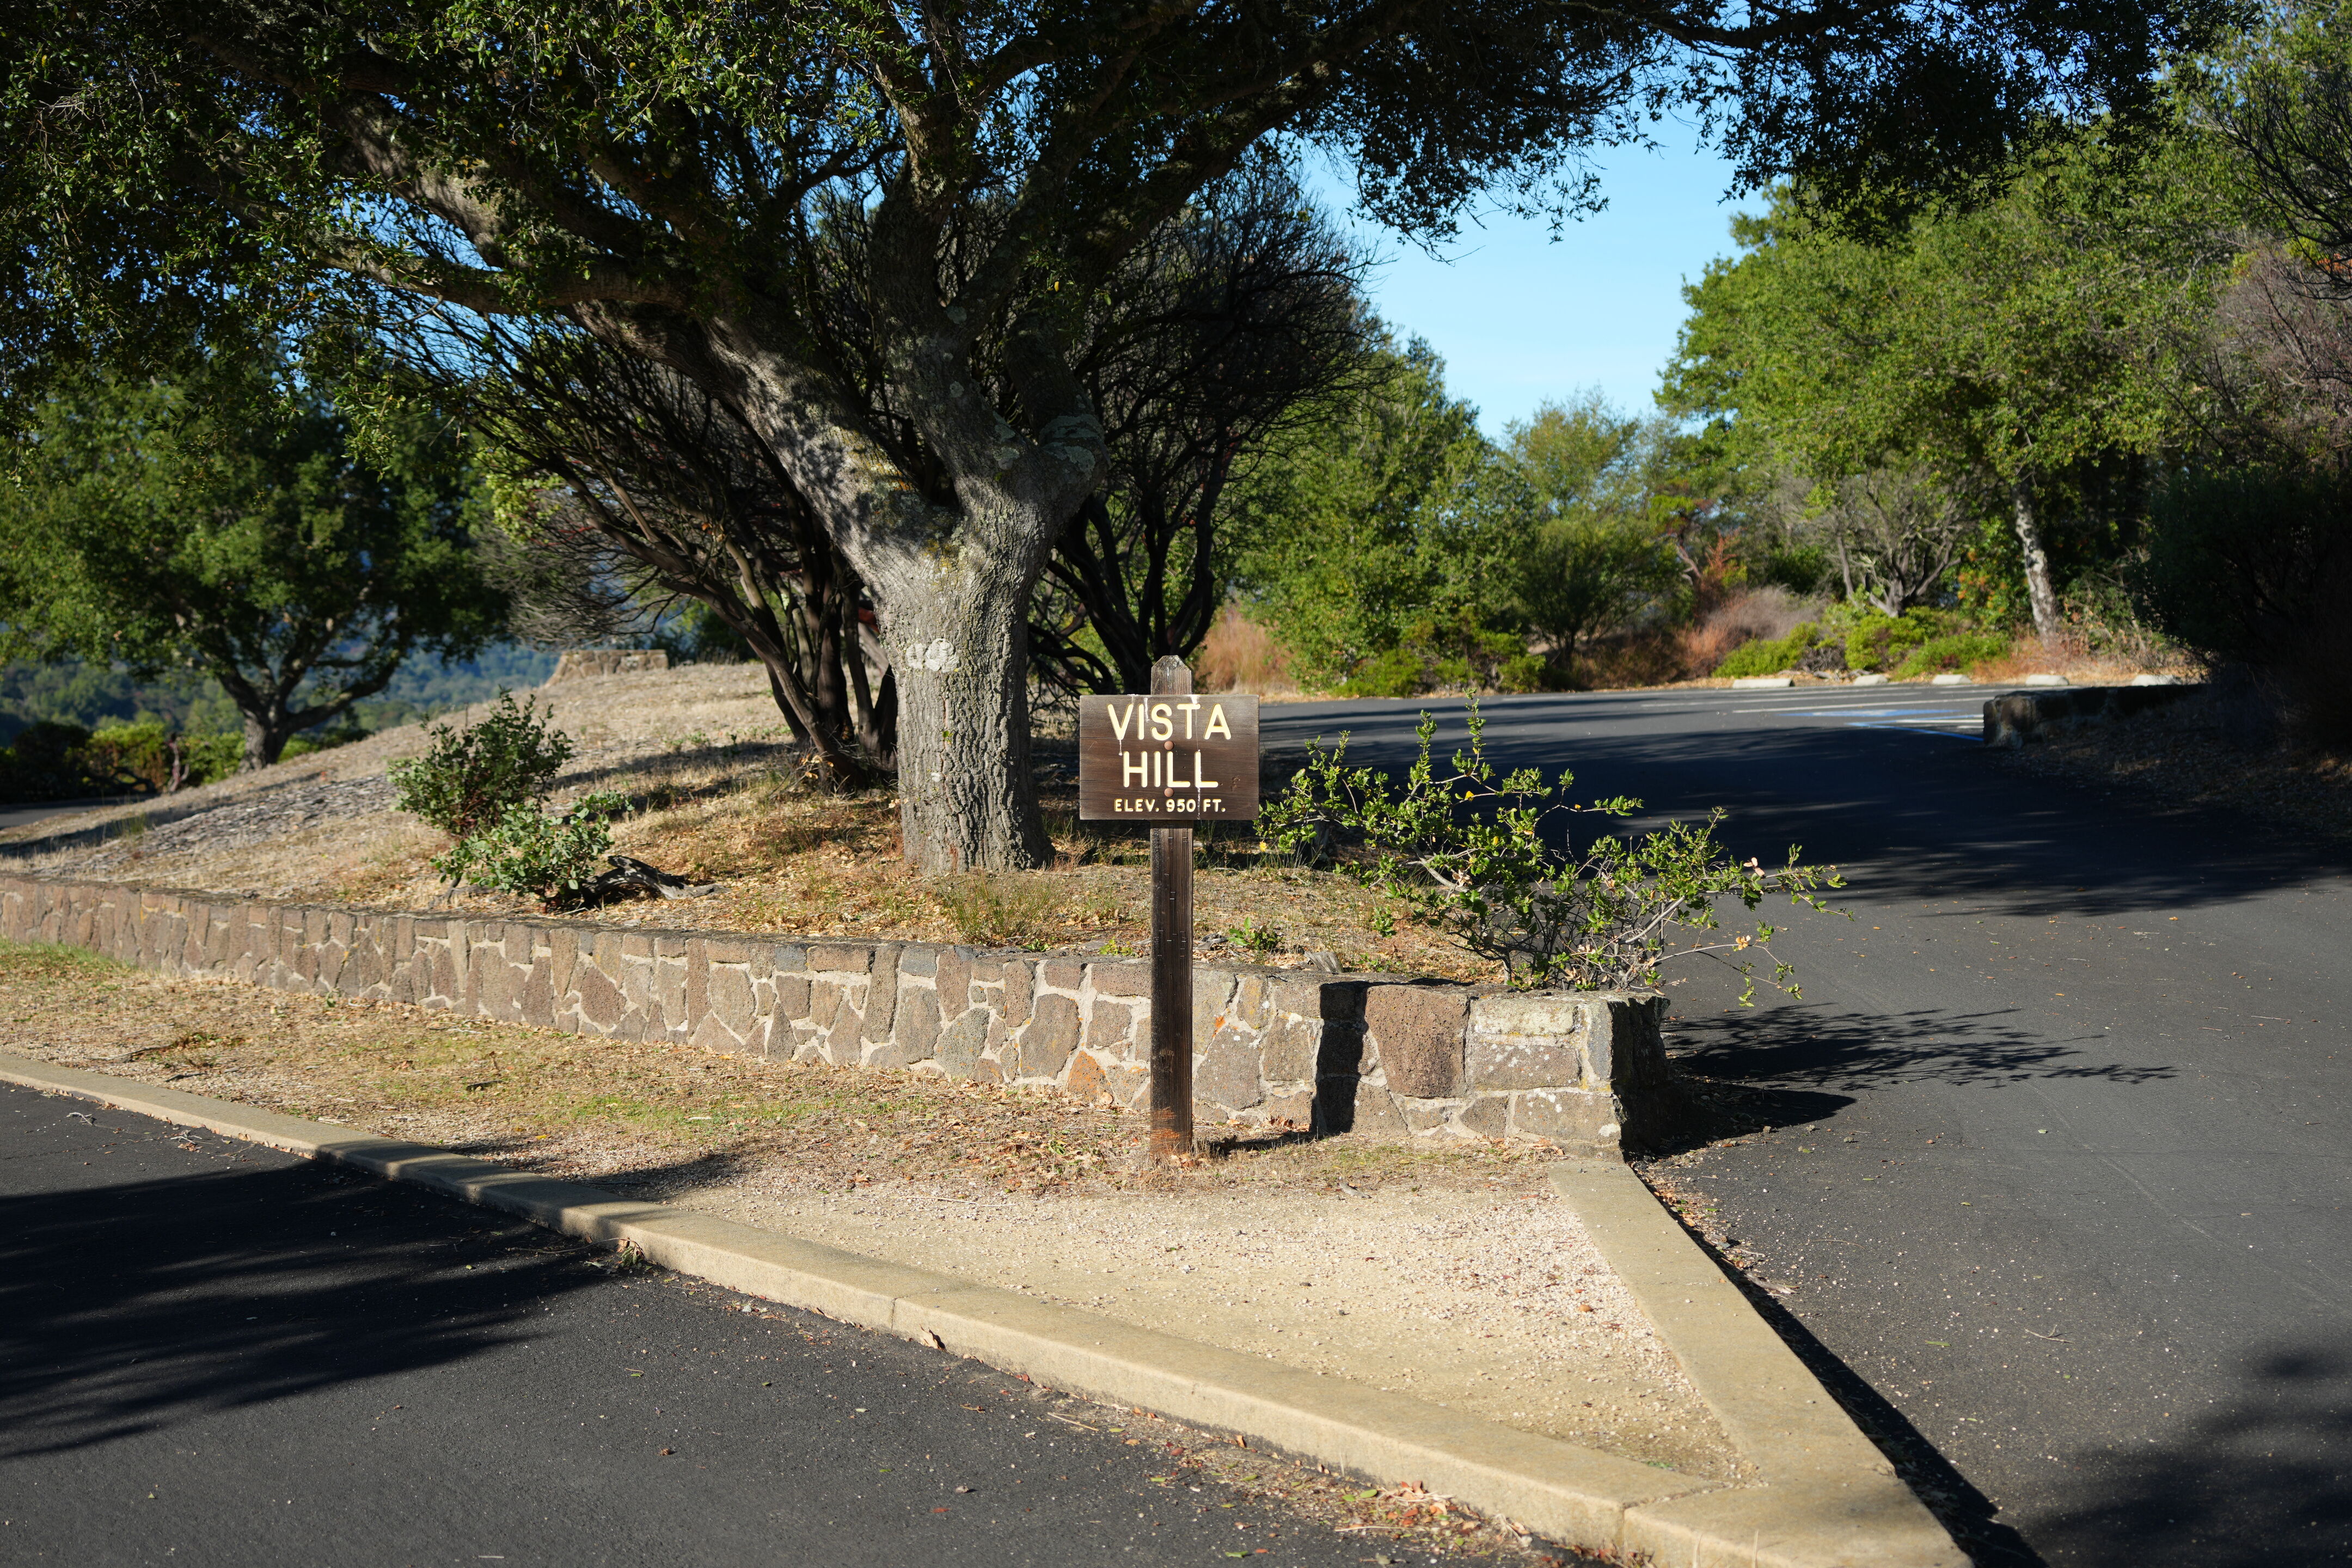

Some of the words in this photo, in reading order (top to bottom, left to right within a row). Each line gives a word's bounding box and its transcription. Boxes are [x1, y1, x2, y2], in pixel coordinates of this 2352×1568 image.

[1107, 703, 1232, 740] VISTA
[1123, 751, 1219, 788] HILL
[1114, 798, 1160, 812] ELEV.
[1166, 798, 1197, 813] 950
[1203, 798, 1226, 812] FT.
